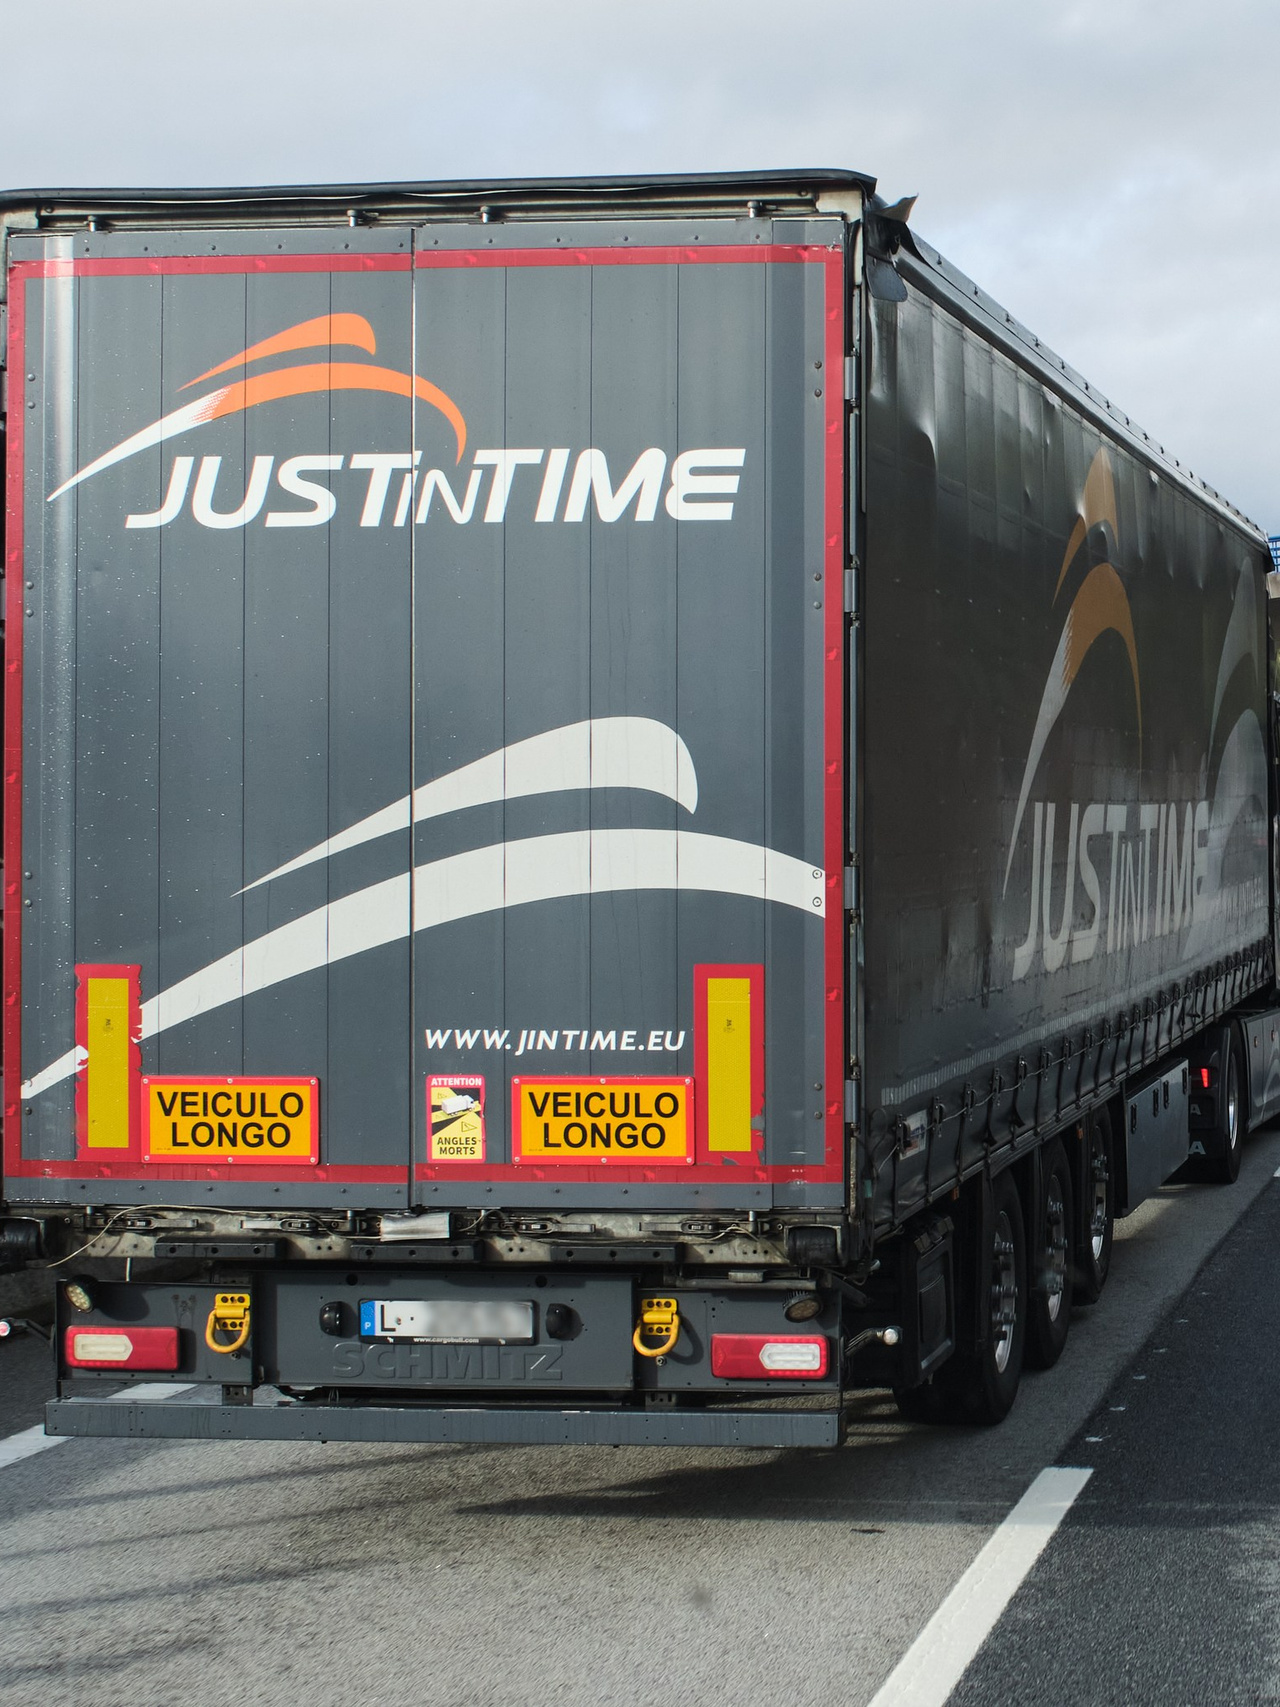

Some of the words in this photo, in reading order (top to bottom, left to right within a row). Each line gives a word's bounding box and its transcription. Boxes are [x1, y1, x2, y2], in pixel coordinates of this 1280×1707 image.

[431, 1077, 482, 1086] ATTENTION
[157, 1091, 304, 1118] VEICULO
[528, 1091, 679, 1118] VEICULO
[172, 1122, 291, 1148] LONGO
[437, 1137, 477, 1145] ANGLES
[544, 1122, 666, 1149] LONGO
[439, 1146, 475, 1155] MORTS
[364, 1321, 371, 1330] P
[413, 1336, 479, 1344] www.cargobull.com
[332, 1341, 563, 1380] SCHMITZ
